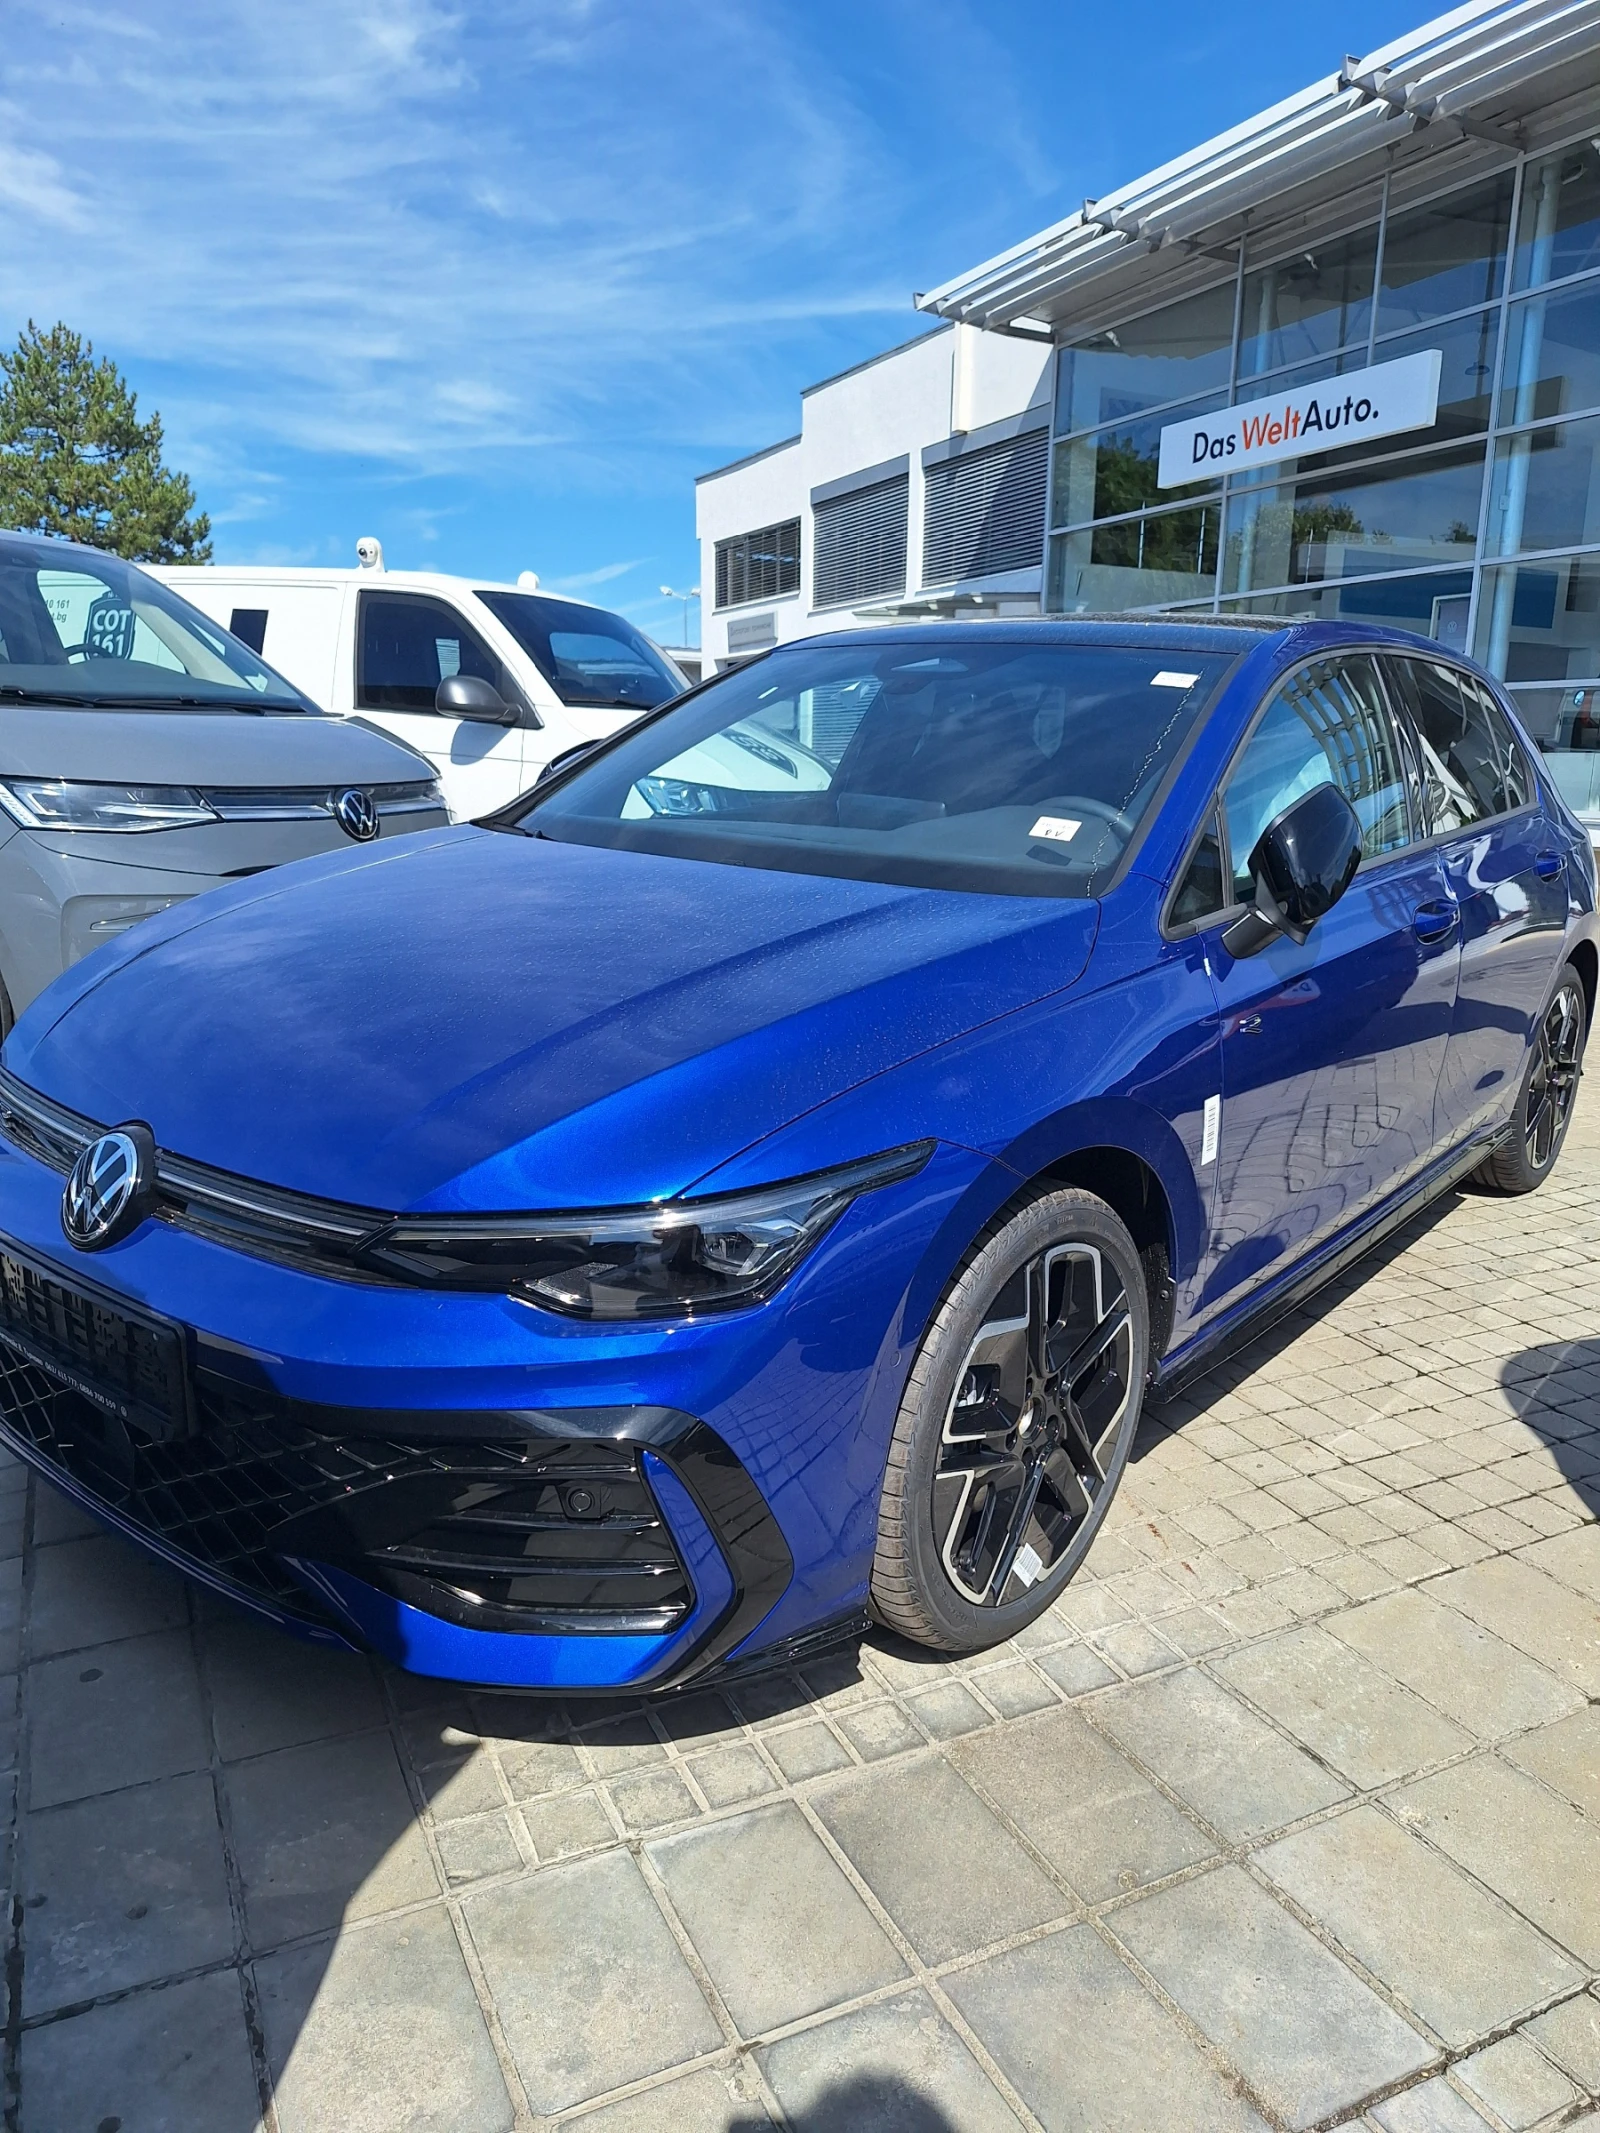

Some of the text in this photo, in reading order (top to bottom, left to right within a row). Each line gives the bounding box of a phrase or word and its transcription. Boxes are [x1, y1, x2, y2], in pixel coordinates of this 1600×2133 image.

[1192, 395, 1379, 464] Das WeltAuto.
[56, 599, 70, 609] 161
